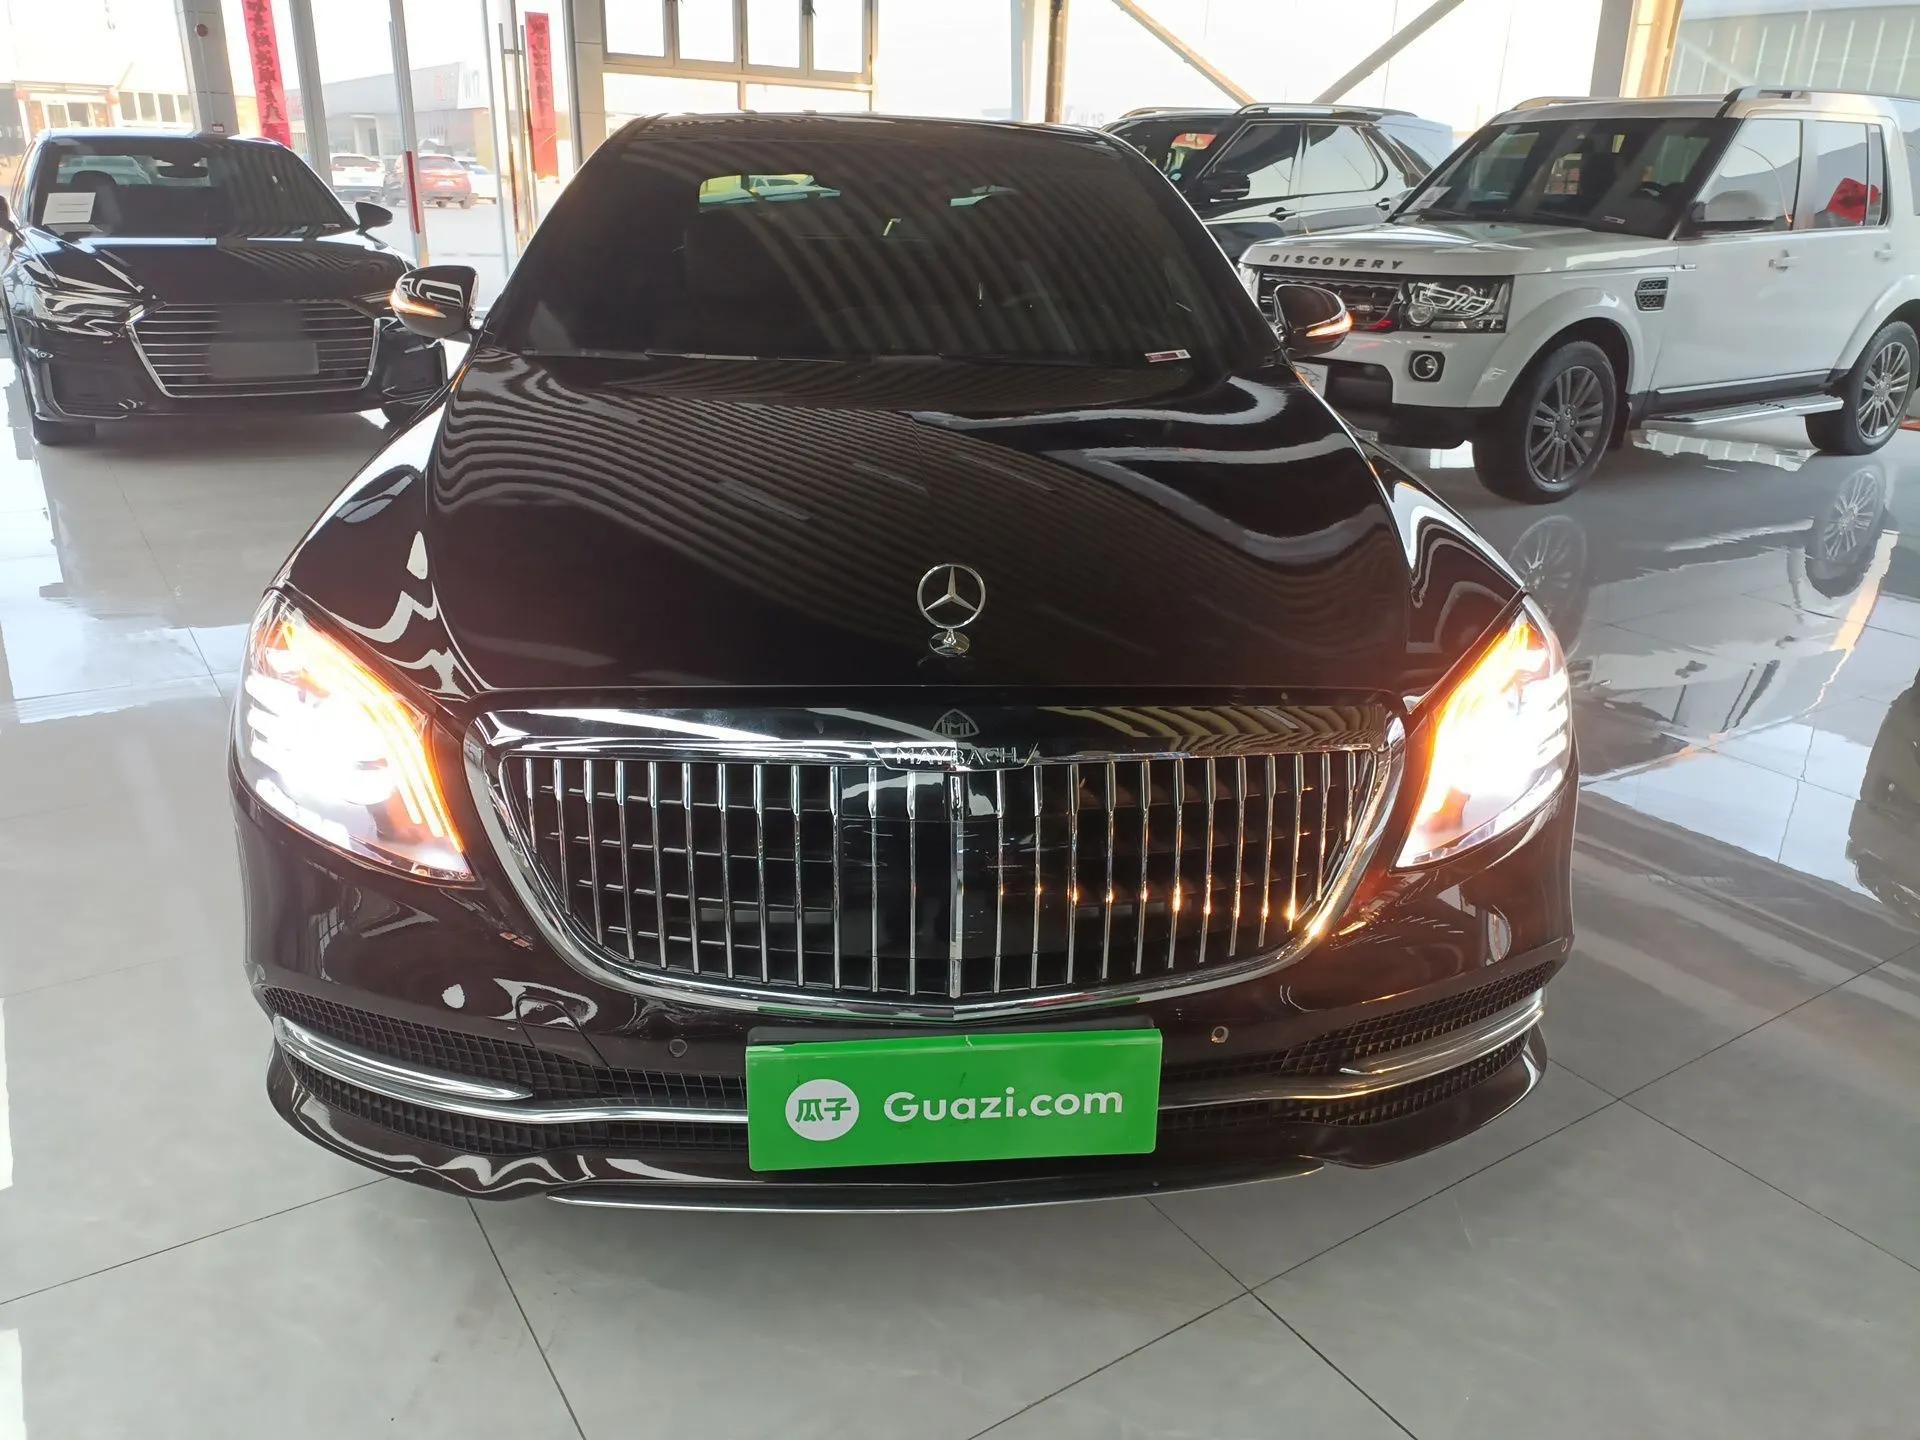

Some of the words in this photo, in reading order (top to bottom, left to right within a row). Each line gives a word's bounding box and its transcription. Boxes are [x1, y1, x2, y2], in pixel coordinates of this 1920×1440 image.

[1269, 253, 1404, 270] DISCOVERY
[895, 747, 1018, 766] MAYBACH
[794, 1096, 852, 1124] 瓜子
[883, 1086, 1124, 1123] Guazi.com
